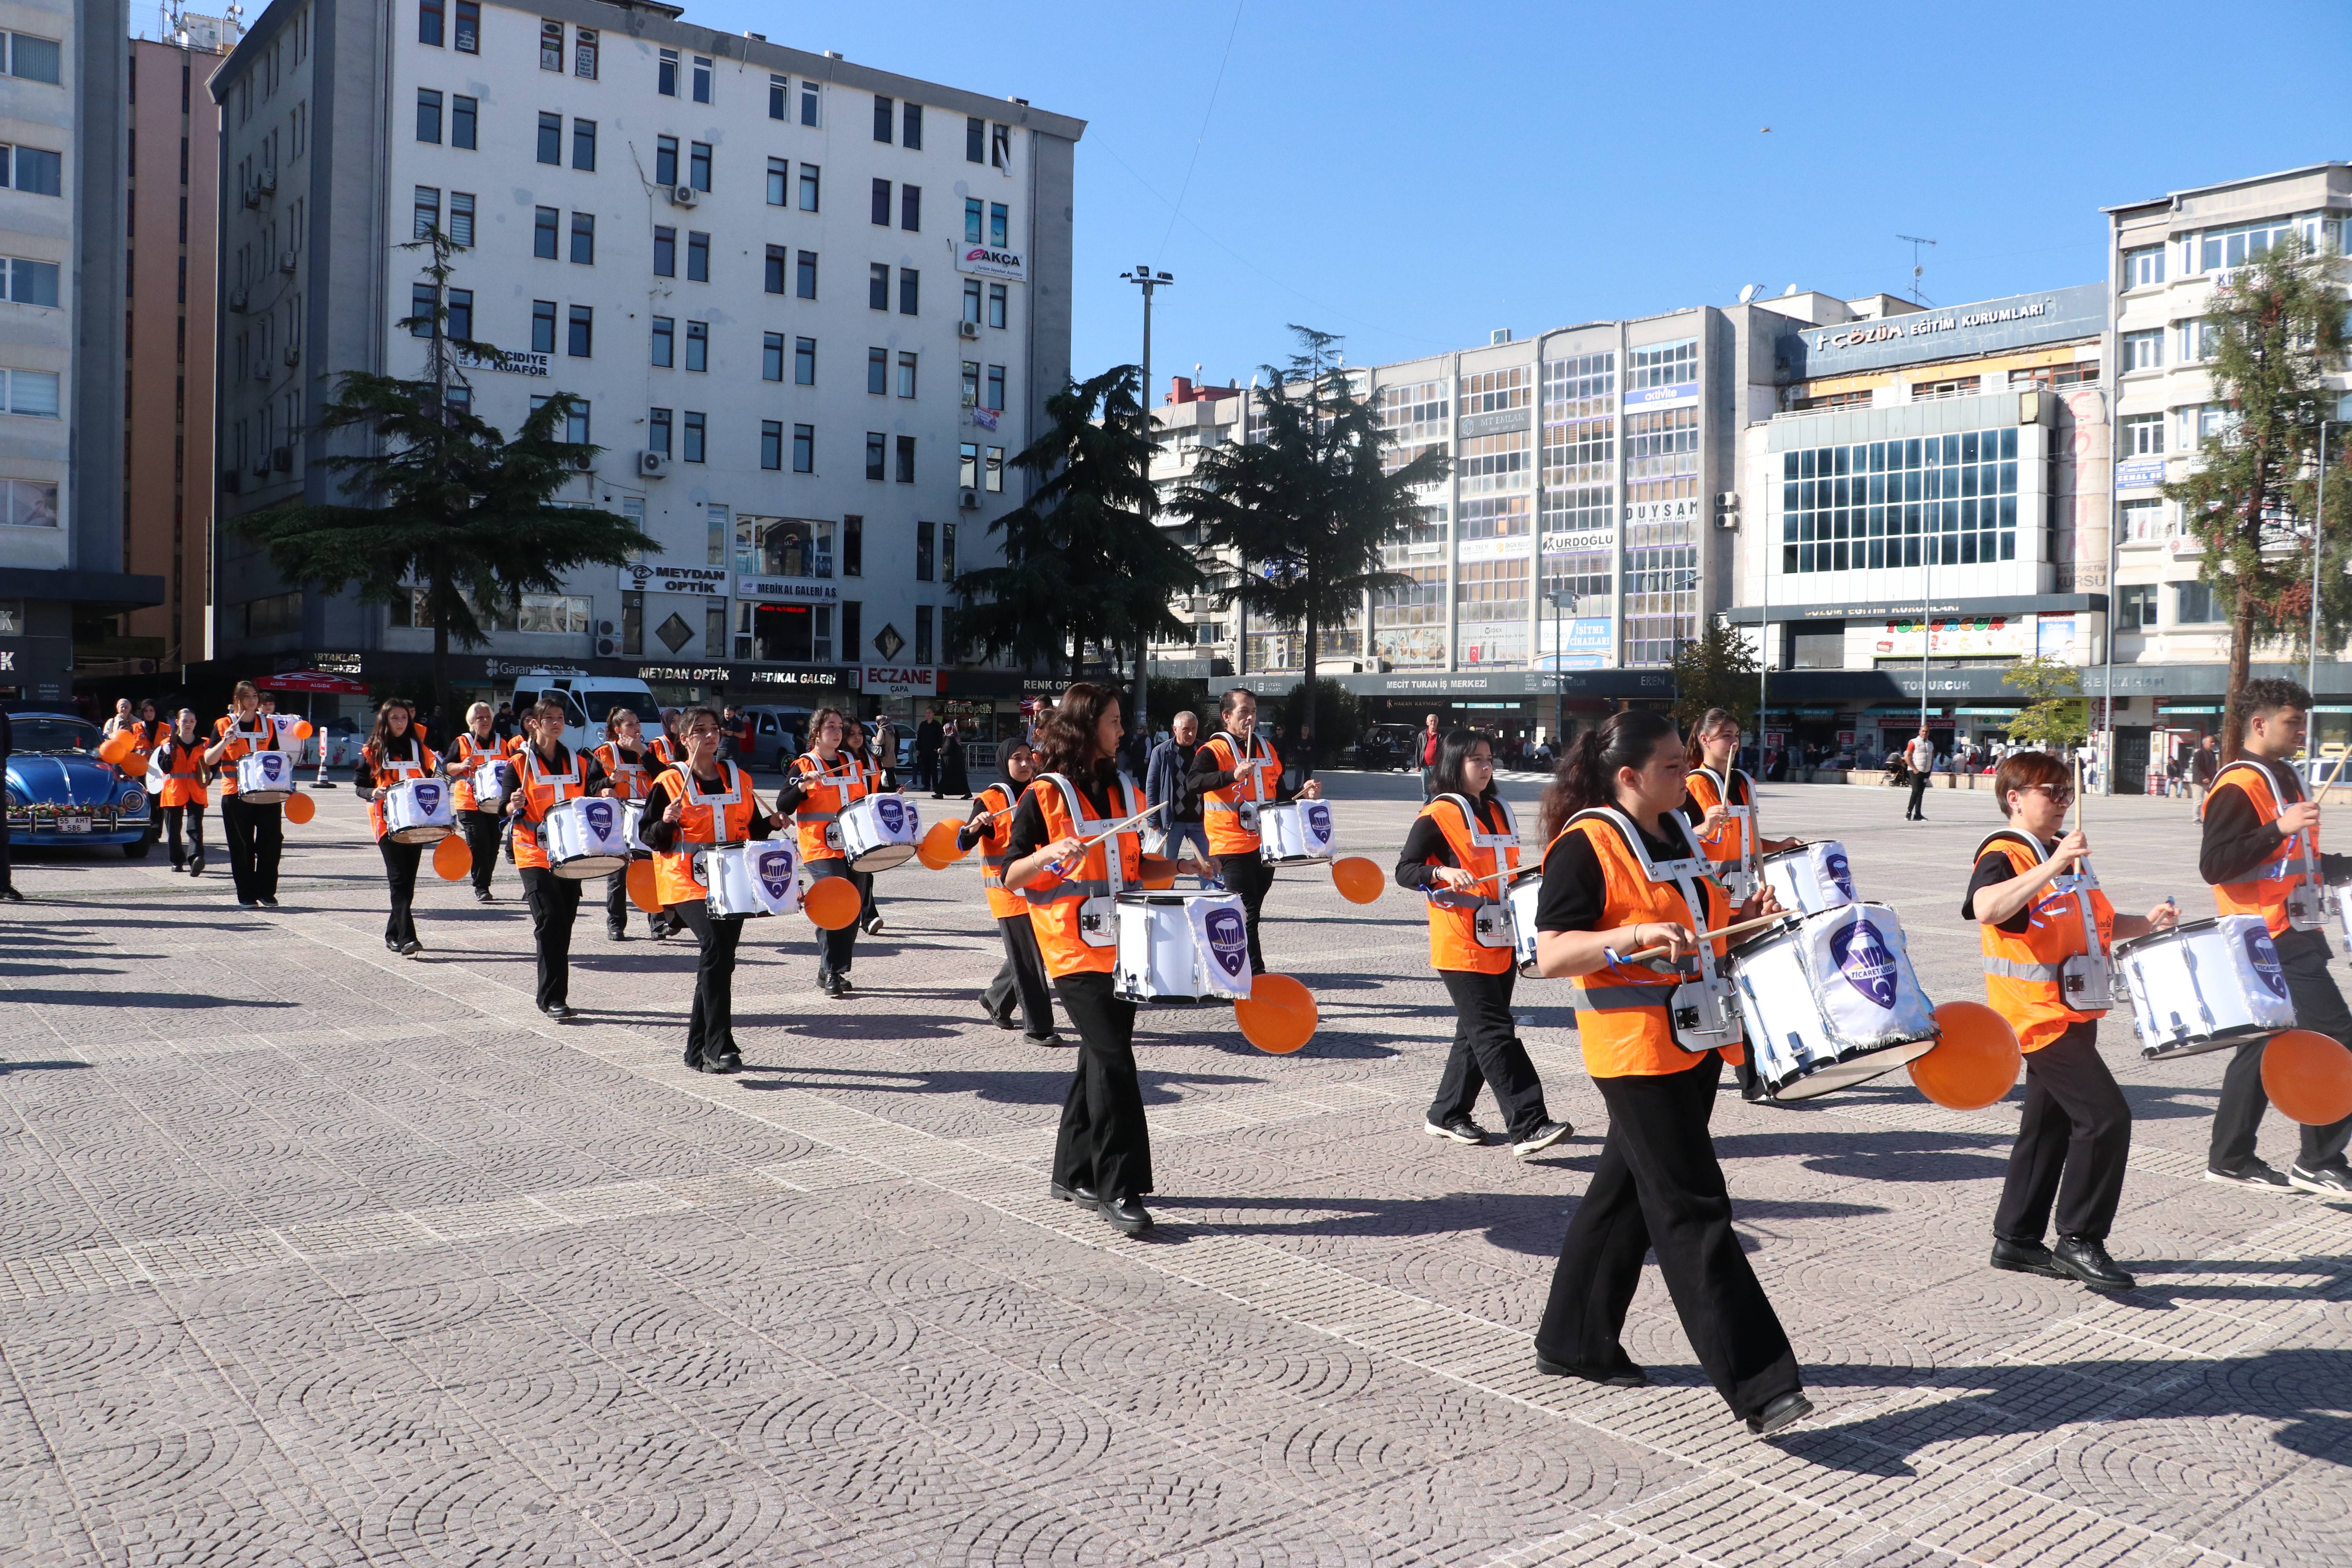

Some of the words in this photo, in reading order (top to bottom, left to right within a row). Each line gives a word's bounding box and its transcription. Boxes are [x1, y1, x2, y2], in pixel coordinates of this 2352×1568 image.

[1831, 325, 1904, 348] ÇÖZÜM
[1910, 317, 1955, 336] EĞİTİM
[1962, 303, 2045, 328] KURUMLARI
[493, 360, 547, 376] KUAFÖR
[1481, 417, 1494, 426] MT
[1496, 413, 1525, 424] EMLAK
[1626, 501, 1698, 520] DUYSAM
[656, 567, 725, 580] MEYDAN
[665, 581, 715, 593] OPTİK
[758, 583, 793, 594] MEDİKAL
[795, 585, 822, 596] GALERİ
[1575, 623, 1605, 636] İŞİTME
[1886, 616, 2008, 633] TOMURCUK
[1570, 636, 1610, 646] CİHAZLARI
[638, 667, 690, 680] MEYDAN
[693, 667, 730, 681] OPTİK
[751, 670, 797, 683] MEDİKAL
[800, 672, 836, 684] GALERİ
[868, 668, 932, 684] ECZANE
[1024, 680, 1053, 690] RENK
[1055, 681, 1072, 690] OP
[1387, 679, 1410, 689] MECİT
[1411, 681, 1438, 689] TURAN
[1440, 678, 1447, 690] İŞ
[1450, 678, 1487, 688] MERKEZİ
[1641, 676, 1665, 686] EREN
[1851, 968, 1881, 979] TİCARET
